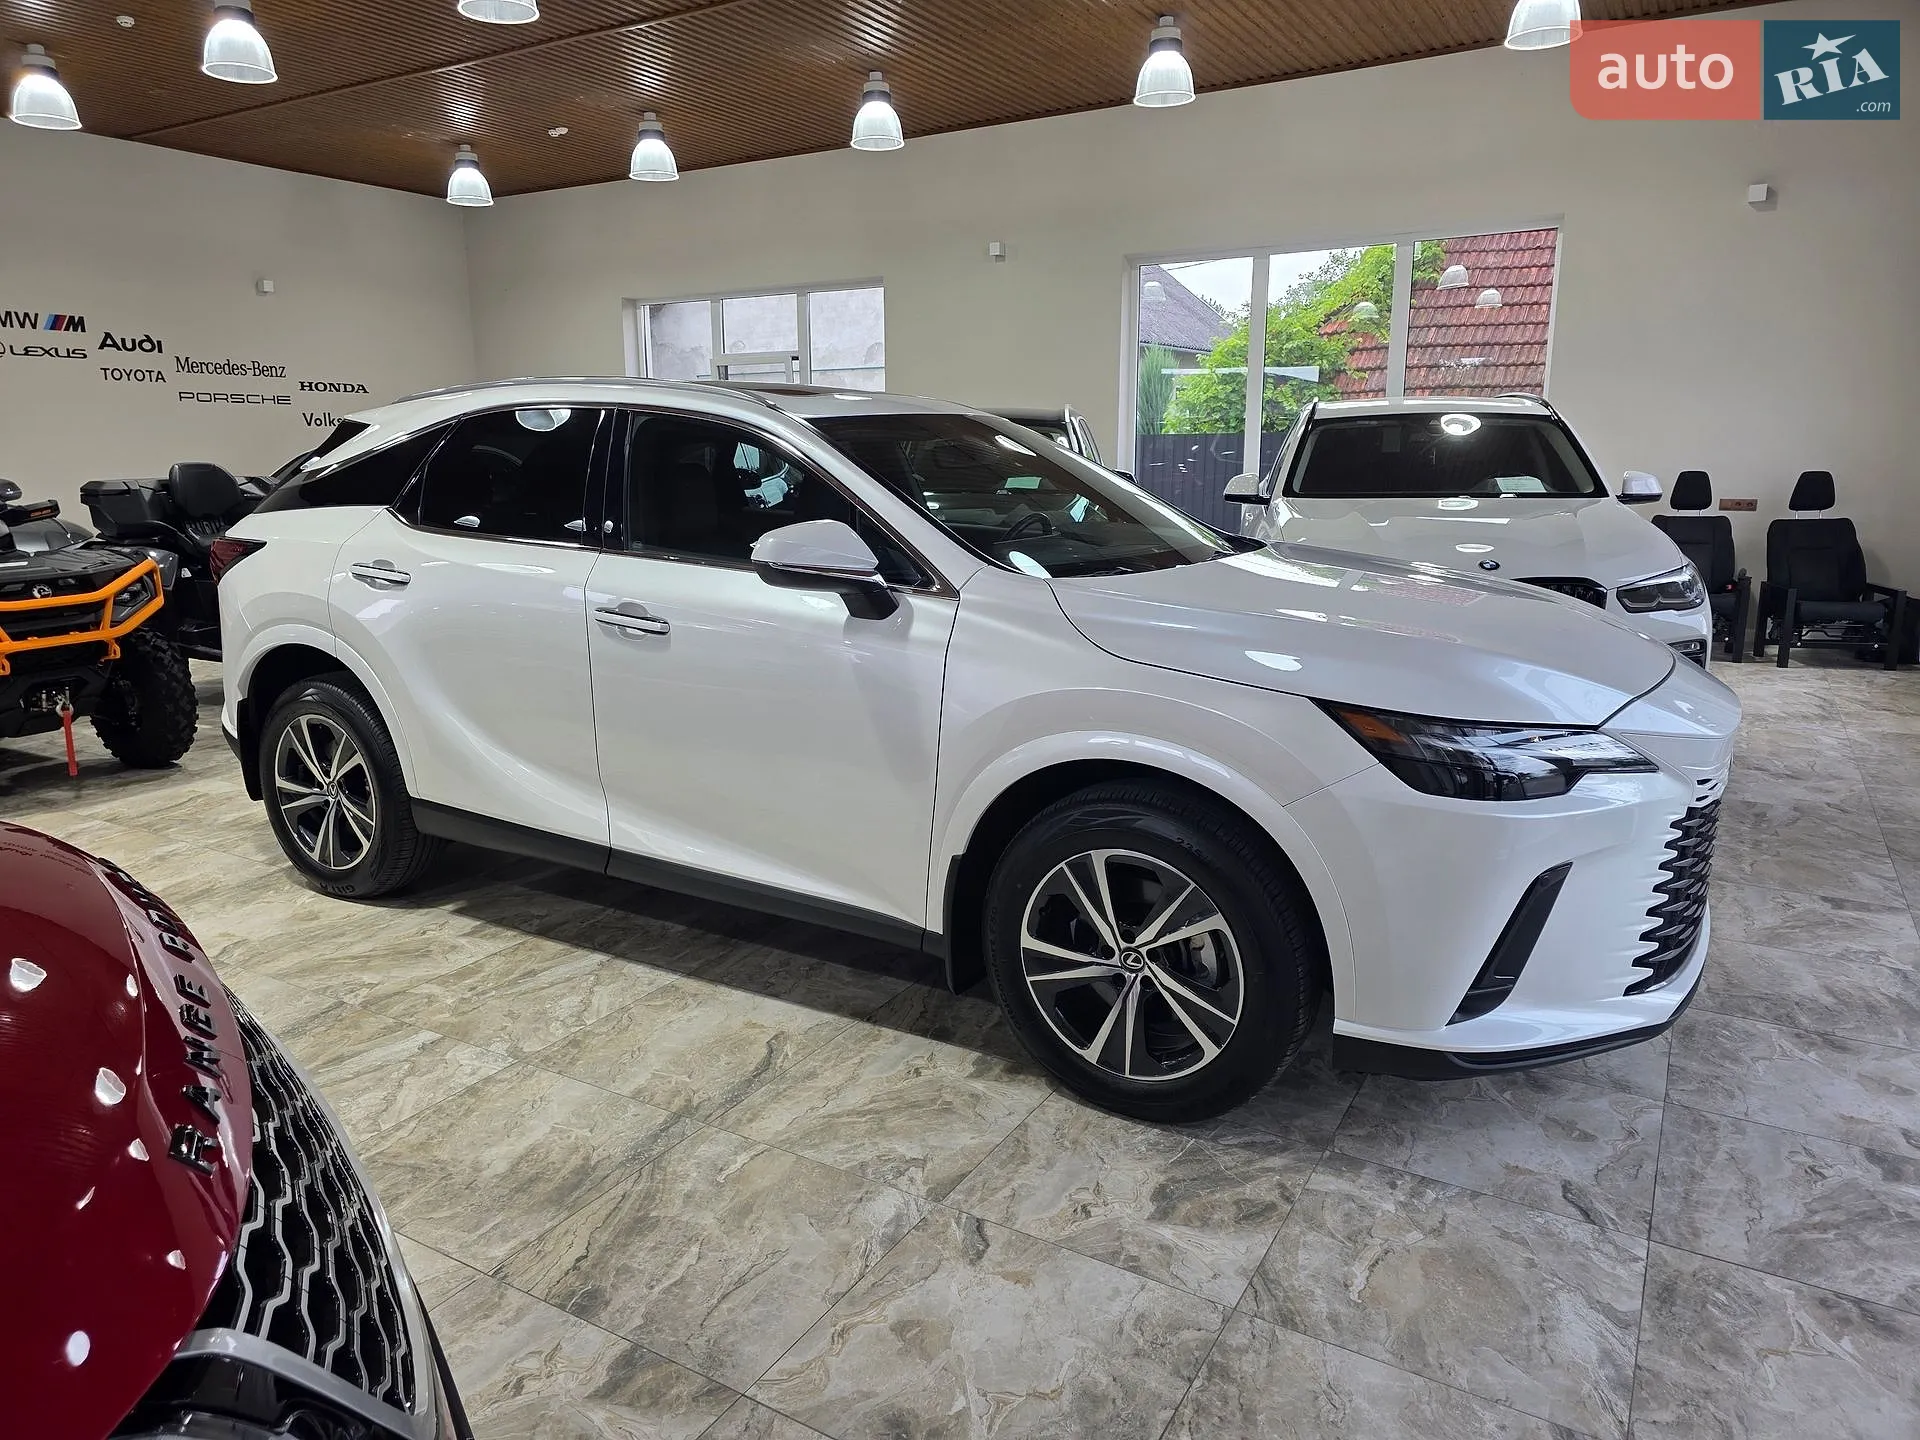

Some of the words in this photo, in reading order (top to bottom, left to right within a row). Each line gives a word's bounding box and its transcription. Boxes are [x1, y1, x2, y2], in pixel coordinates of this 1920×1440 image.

[63, 315, 87, 333] M
[97, 331, 164, 354] Audi
[9, 344, 88, 359] LEXUS
[99, 367, 167, 383] TOYOTA
[174, 355, 287, 379] Mercedes-Benz
[298, 381, 370, 394] HONDA
[178, 391, 292, 405] PORSCHE
[167, 972, 223, 1178] RANGE
